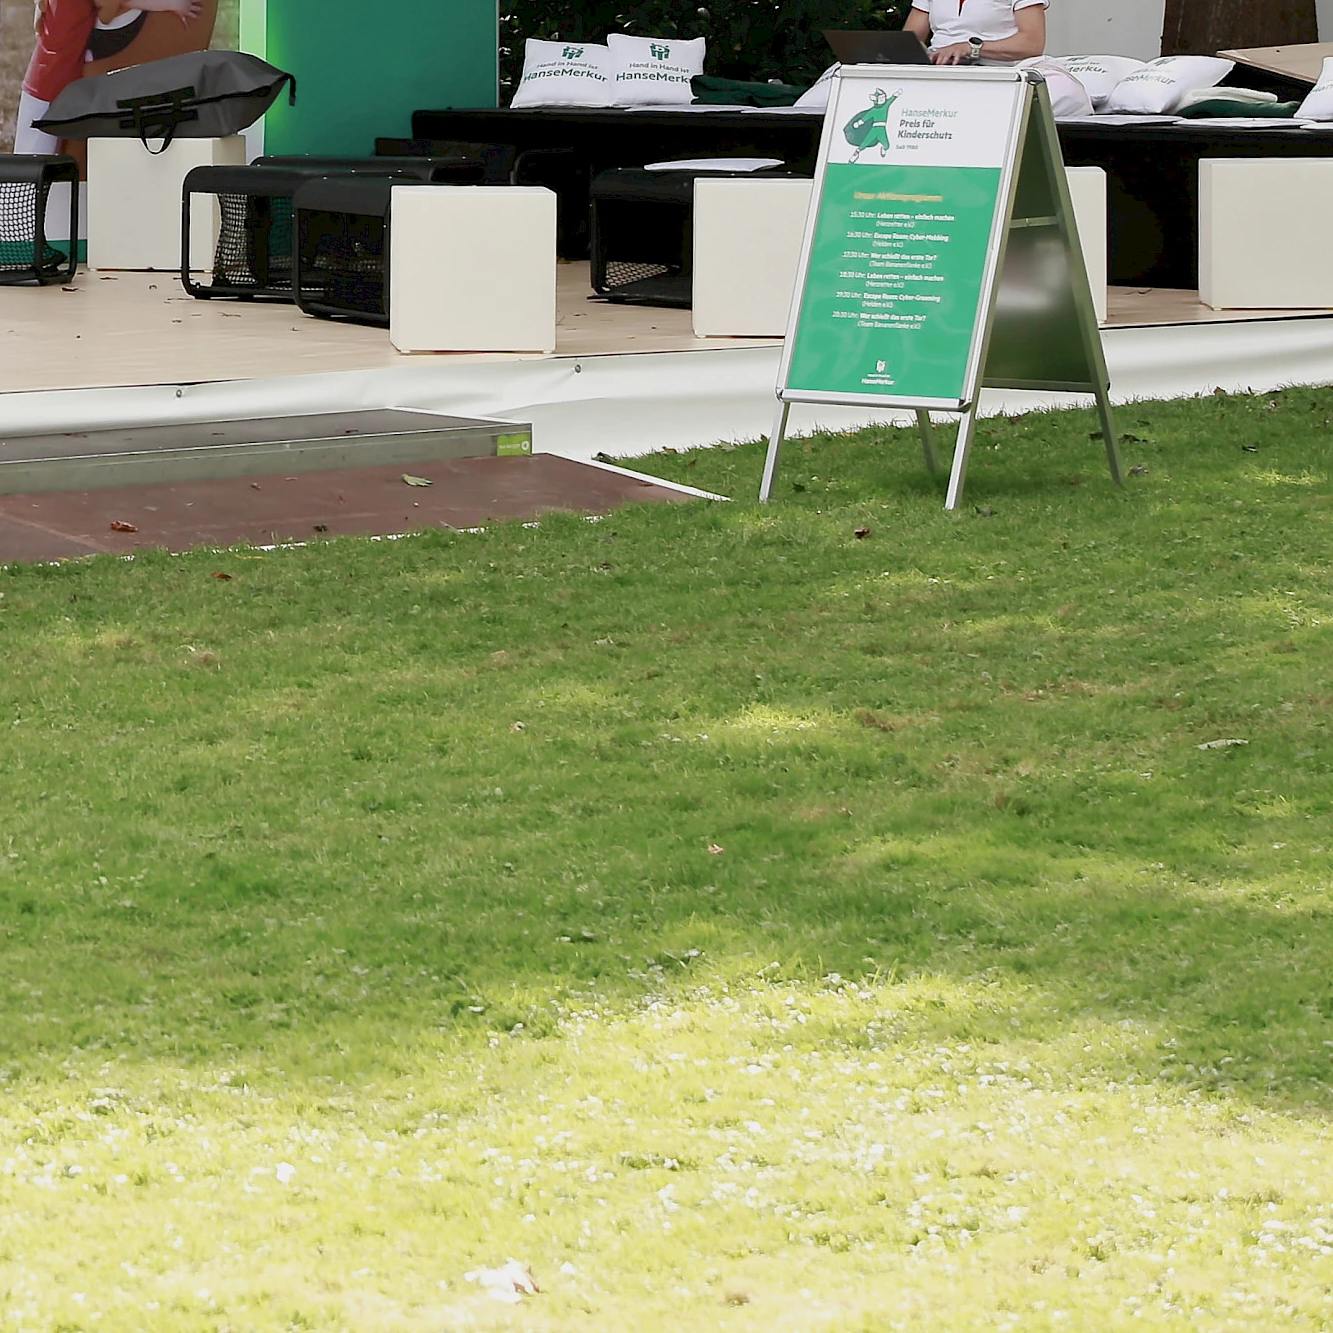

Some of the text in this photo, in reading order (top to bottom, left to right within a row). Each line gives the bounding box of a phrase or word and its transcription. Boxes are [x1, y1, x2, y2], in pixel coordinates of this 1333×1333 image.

[524, 68, 608, 83] HanseMerkur
[616, 71, 690, 84] HanseMerk
[901, 108, 958, 118] HanseMerkur
[899, 119, 935, 128] Preis für
[898, 130, 952, 140] Kinderschutz
